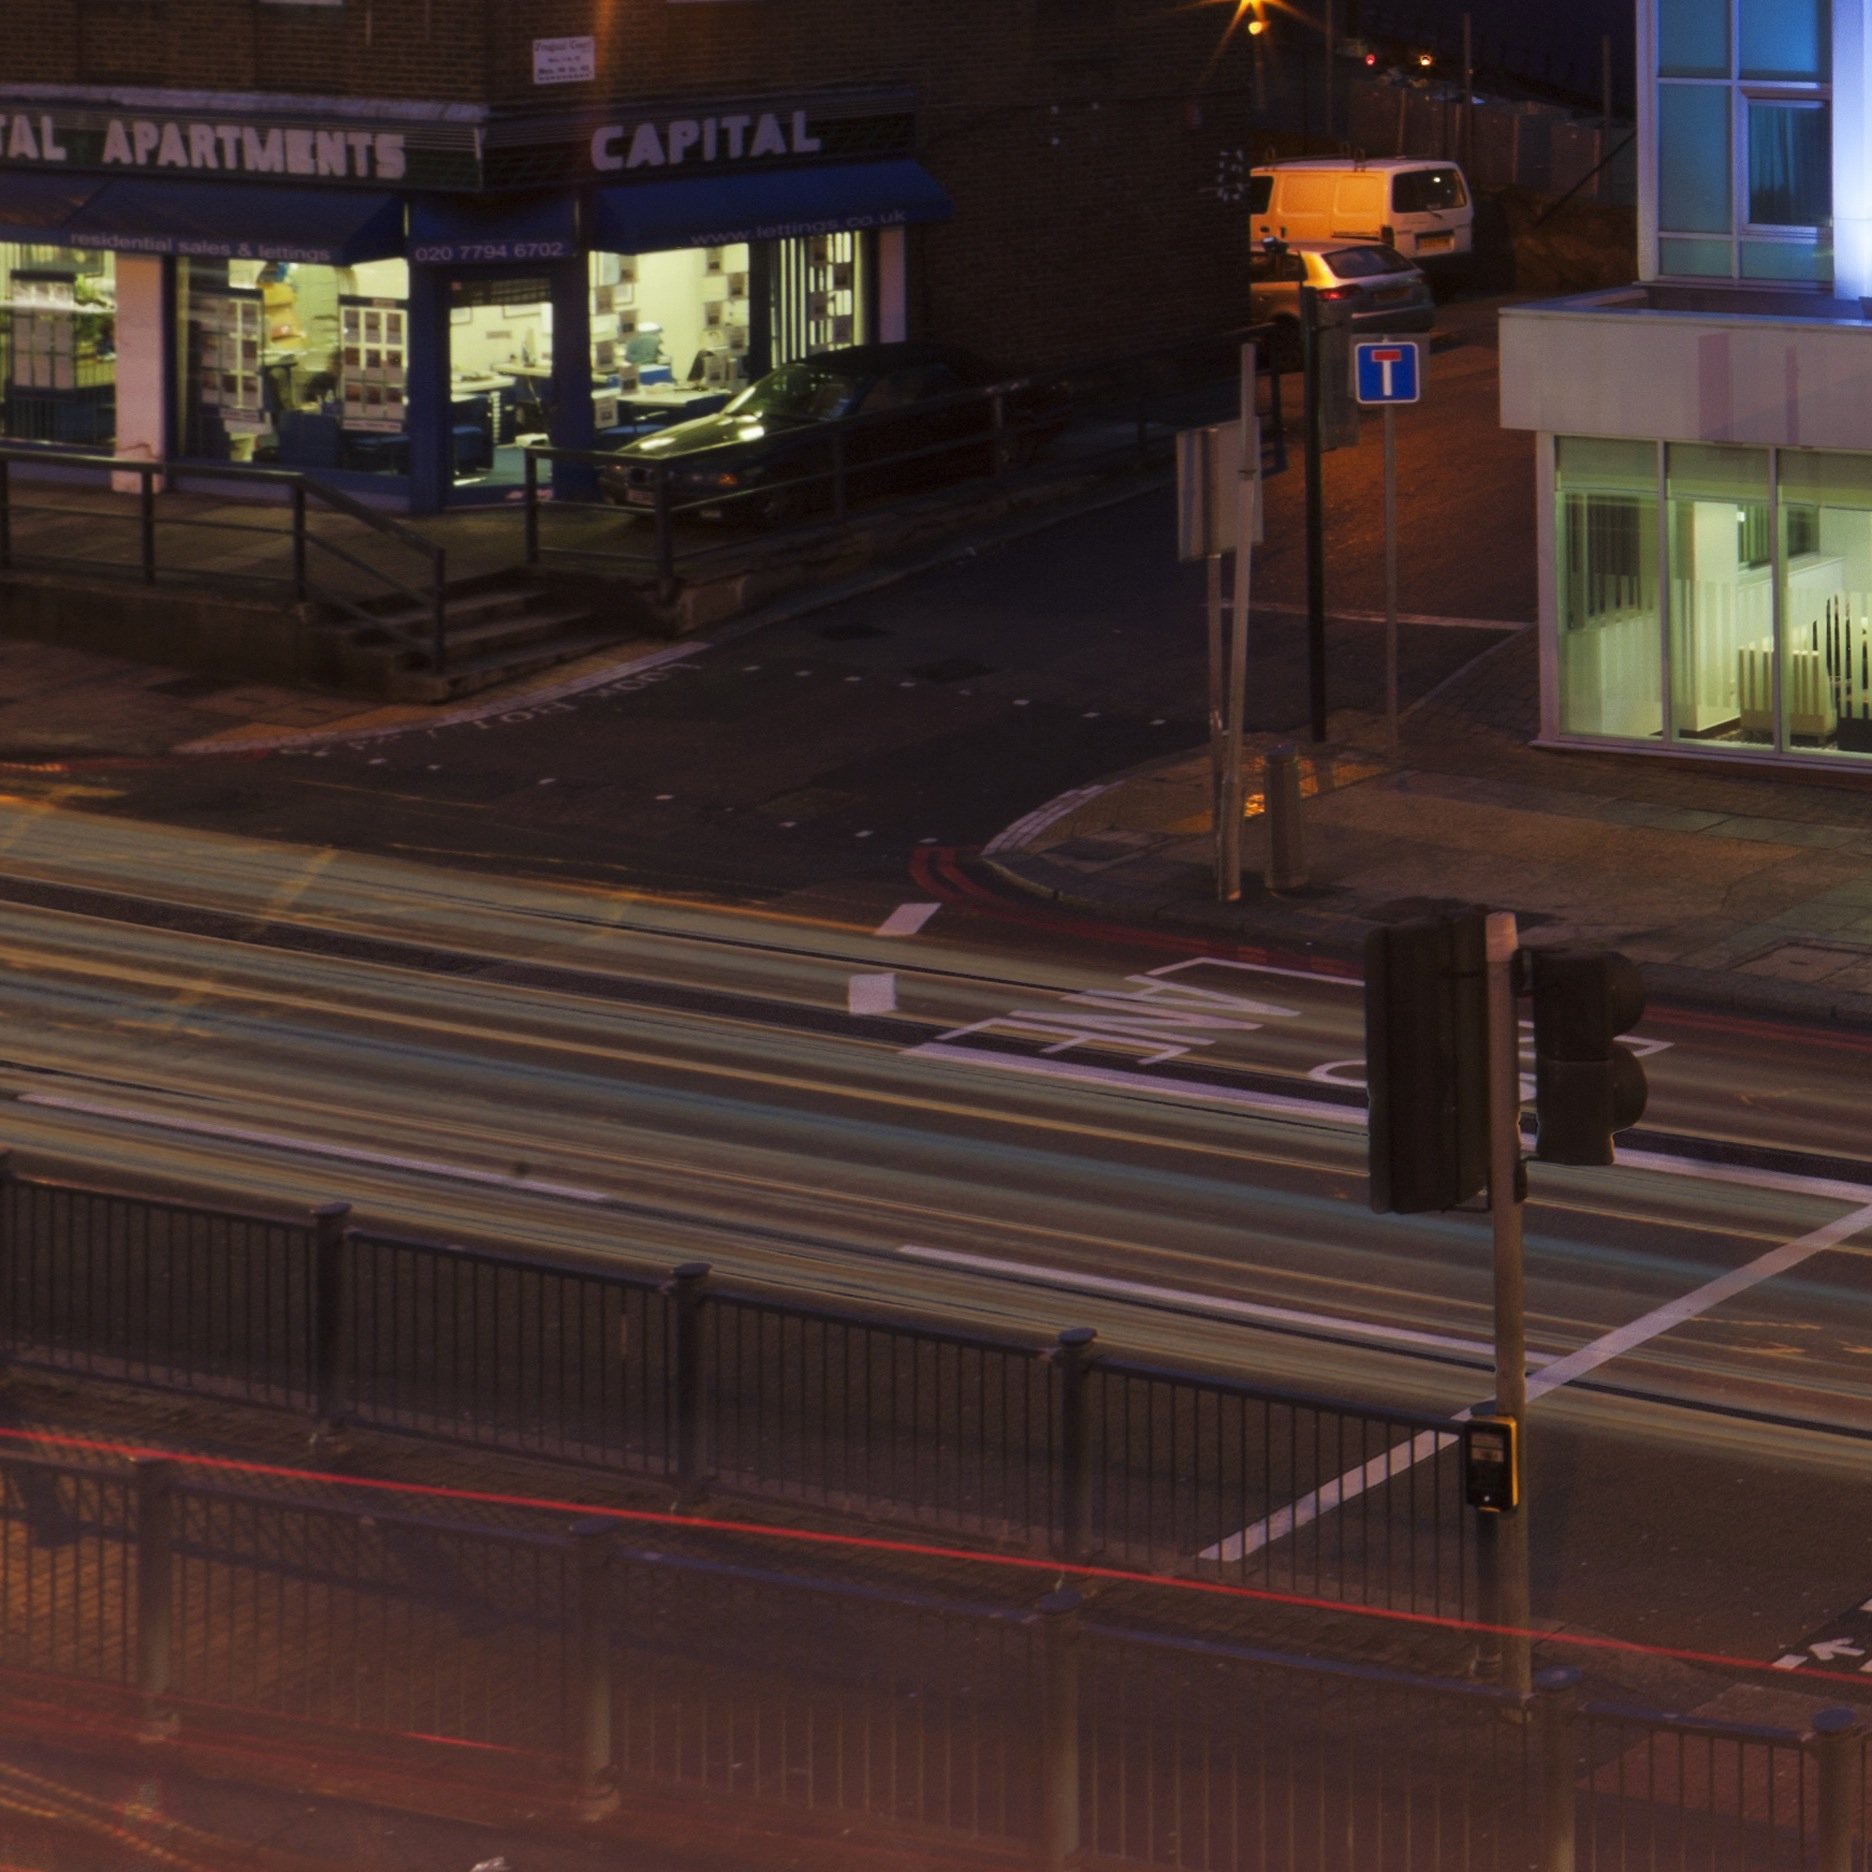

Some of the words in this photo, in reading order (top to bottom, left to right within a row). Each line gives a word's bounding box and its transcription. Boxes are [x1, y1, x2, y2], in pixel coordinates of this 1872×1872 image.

[102, 119, 407, 180] APARTMENTS
[591, 111, 822, 171] CAPITAL
[690, 210, 907, 245] www.lettings.co.uk
[70, 233, 173, 254] residential
[178, 240, 231, 256] sales
[237, 242, 253, 257] &
[258, 244, 331, 262] lettings
[415, 246, 453, 262] 020
[459, 244, 507, 260] 7794
[513, 241, 563, 259] 6702
